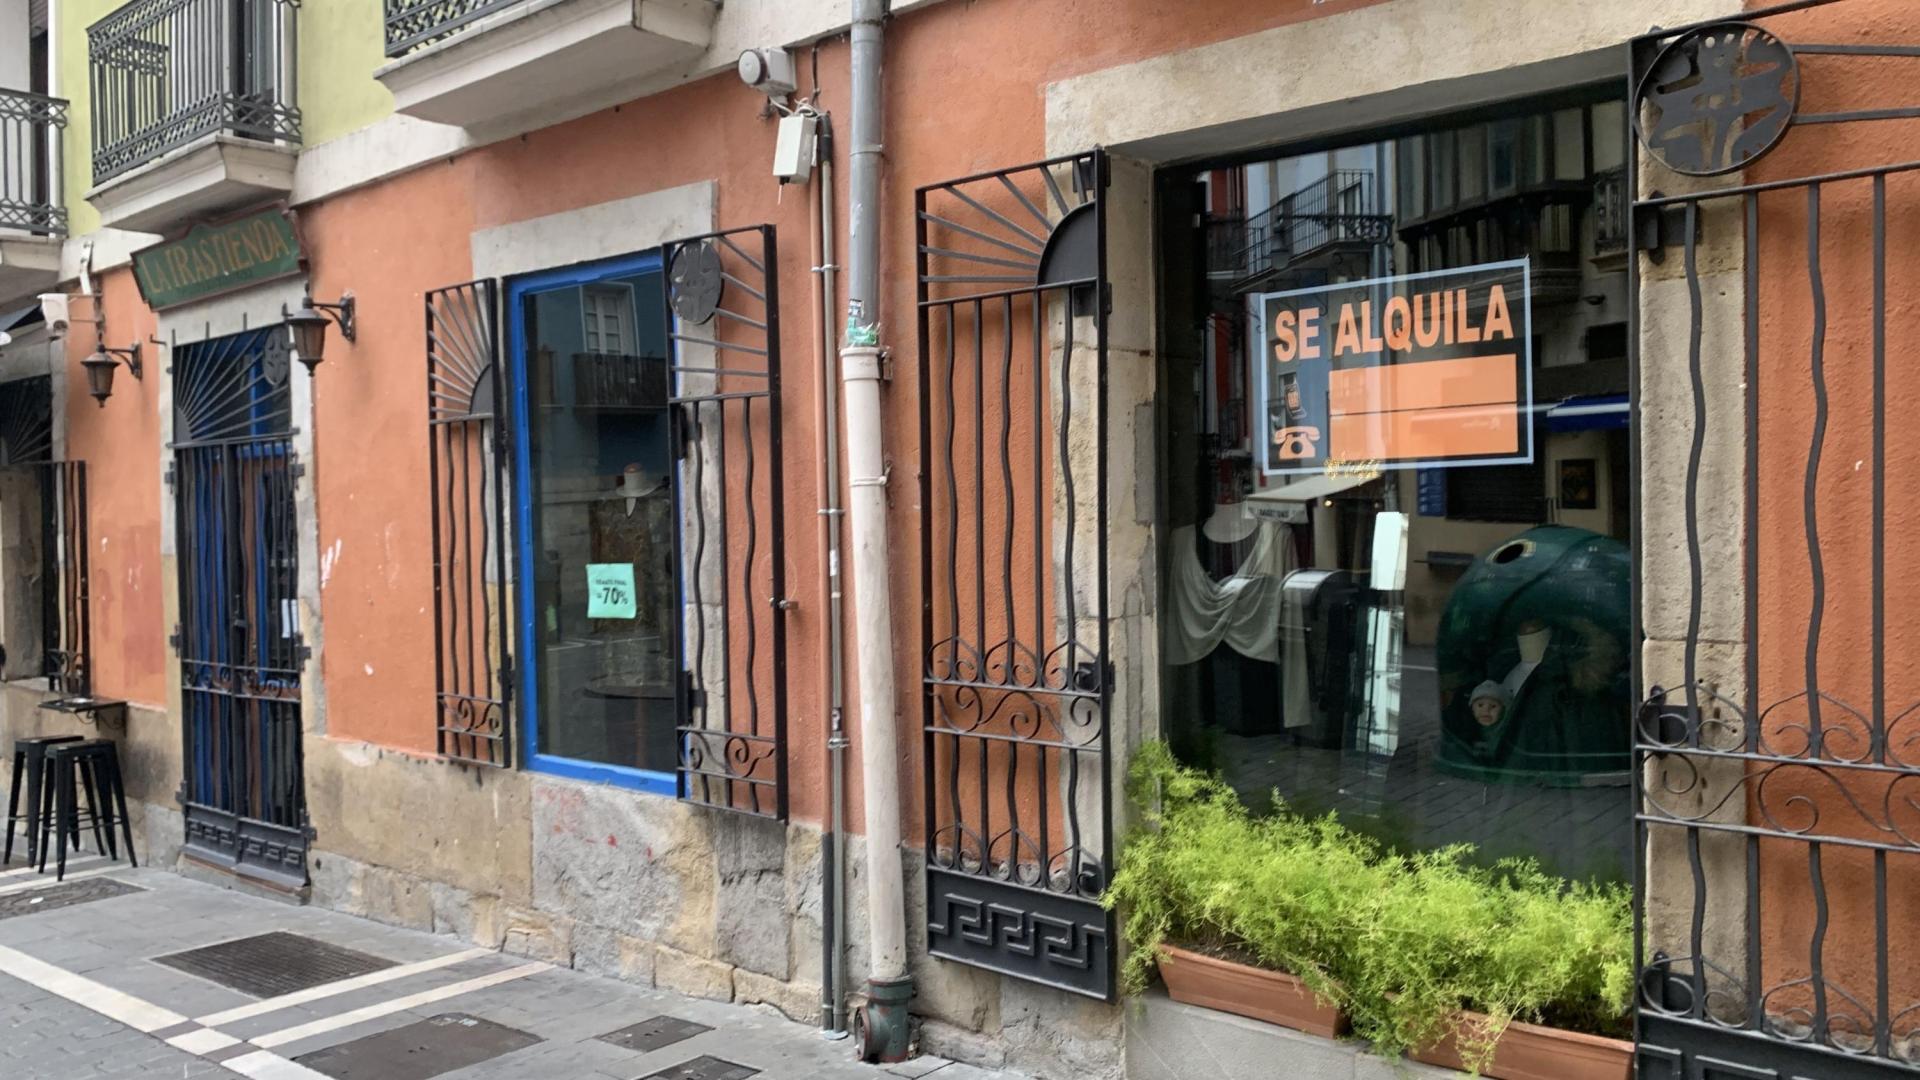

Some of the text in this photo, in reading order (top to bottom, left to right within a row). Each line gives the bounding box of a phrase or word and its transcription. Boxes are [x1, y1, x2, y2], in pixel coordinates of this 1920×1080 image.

[165, 219, 291, 288] TRASTIENDA
[1274, 284, 1515, 363] SE ALQUILA
[596, 587, 628, 605] -70%
